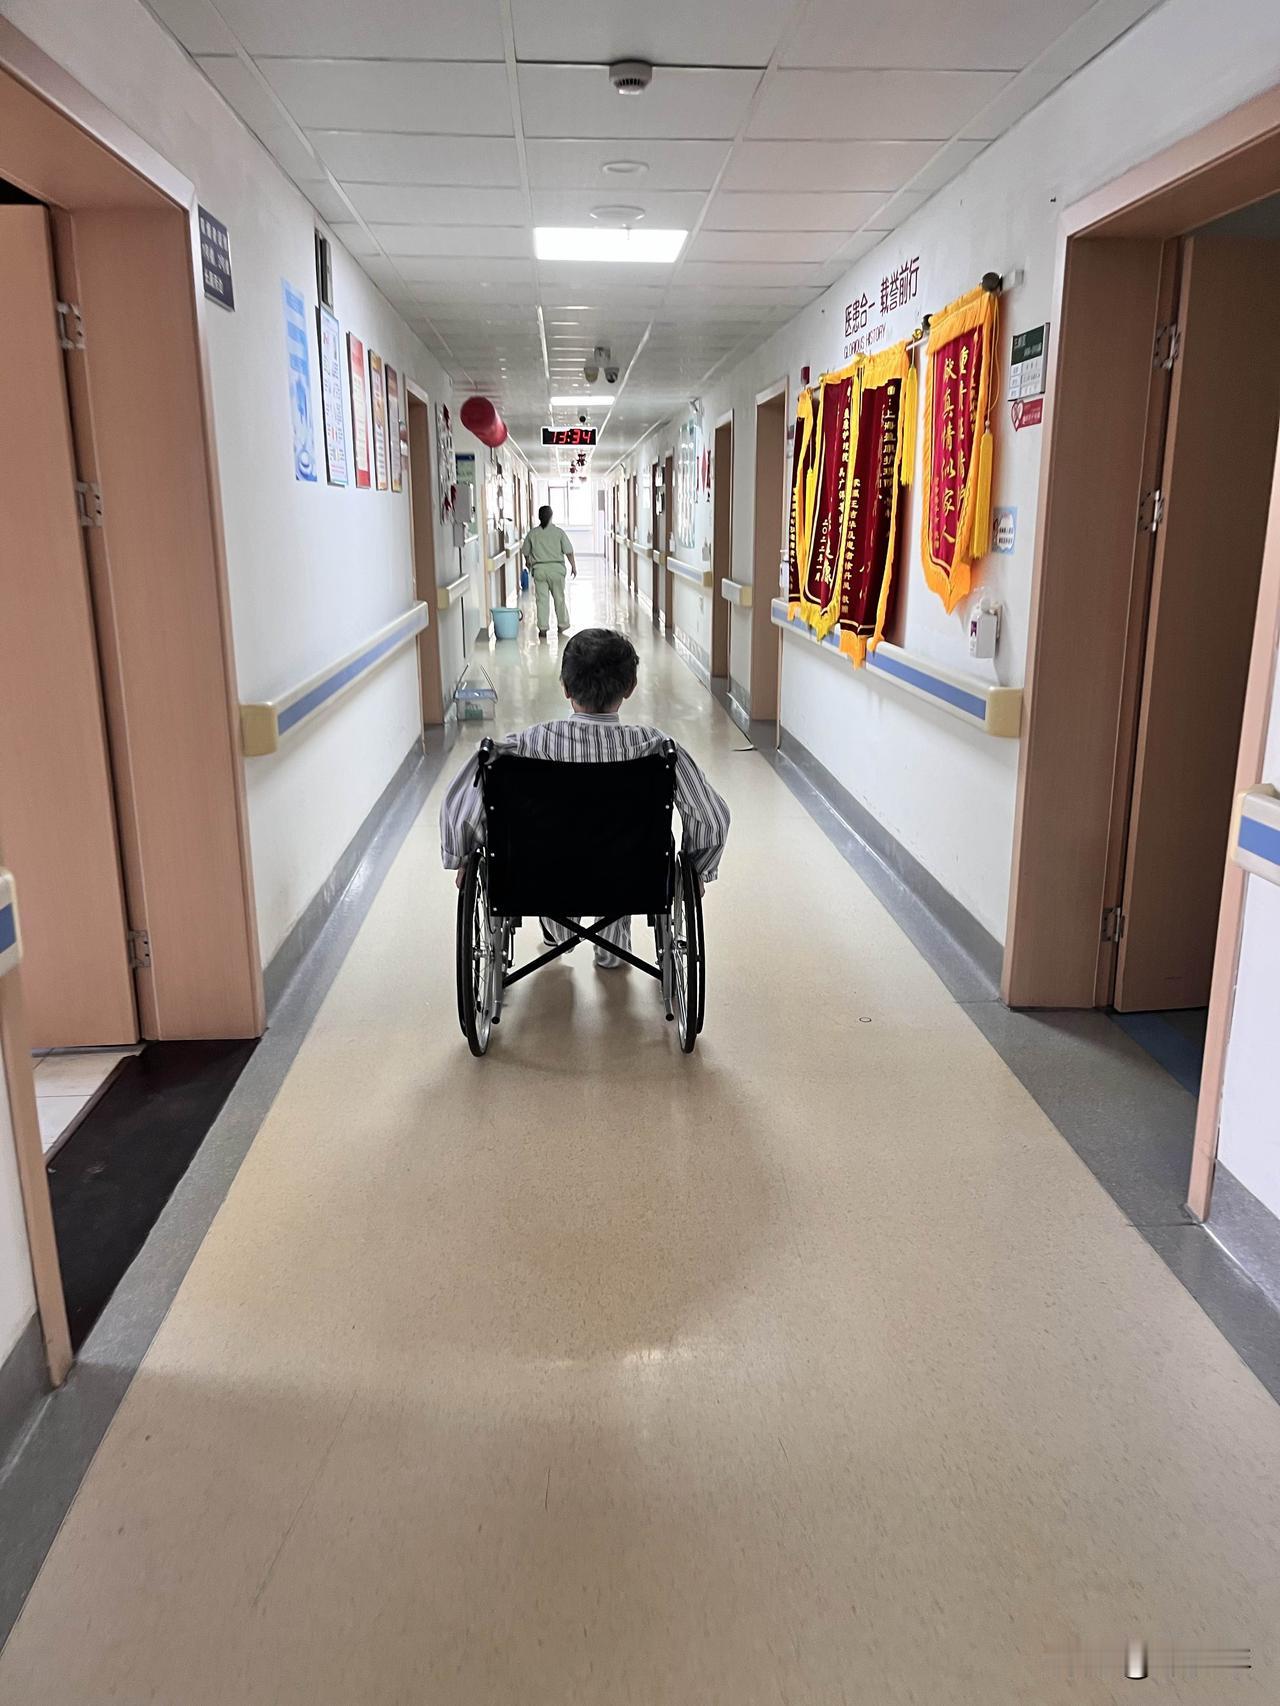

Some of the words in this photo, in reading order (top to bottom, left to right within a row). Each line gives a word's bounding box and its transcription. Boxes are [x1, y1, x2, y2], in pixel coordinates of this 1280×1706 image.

[845, 293, 875, 337] 医患合一
[880, 256, 919, 316] 载誉前行
[866, 323, 887, 347] HISTORY
[552, 429, 592, 444] 13:34
